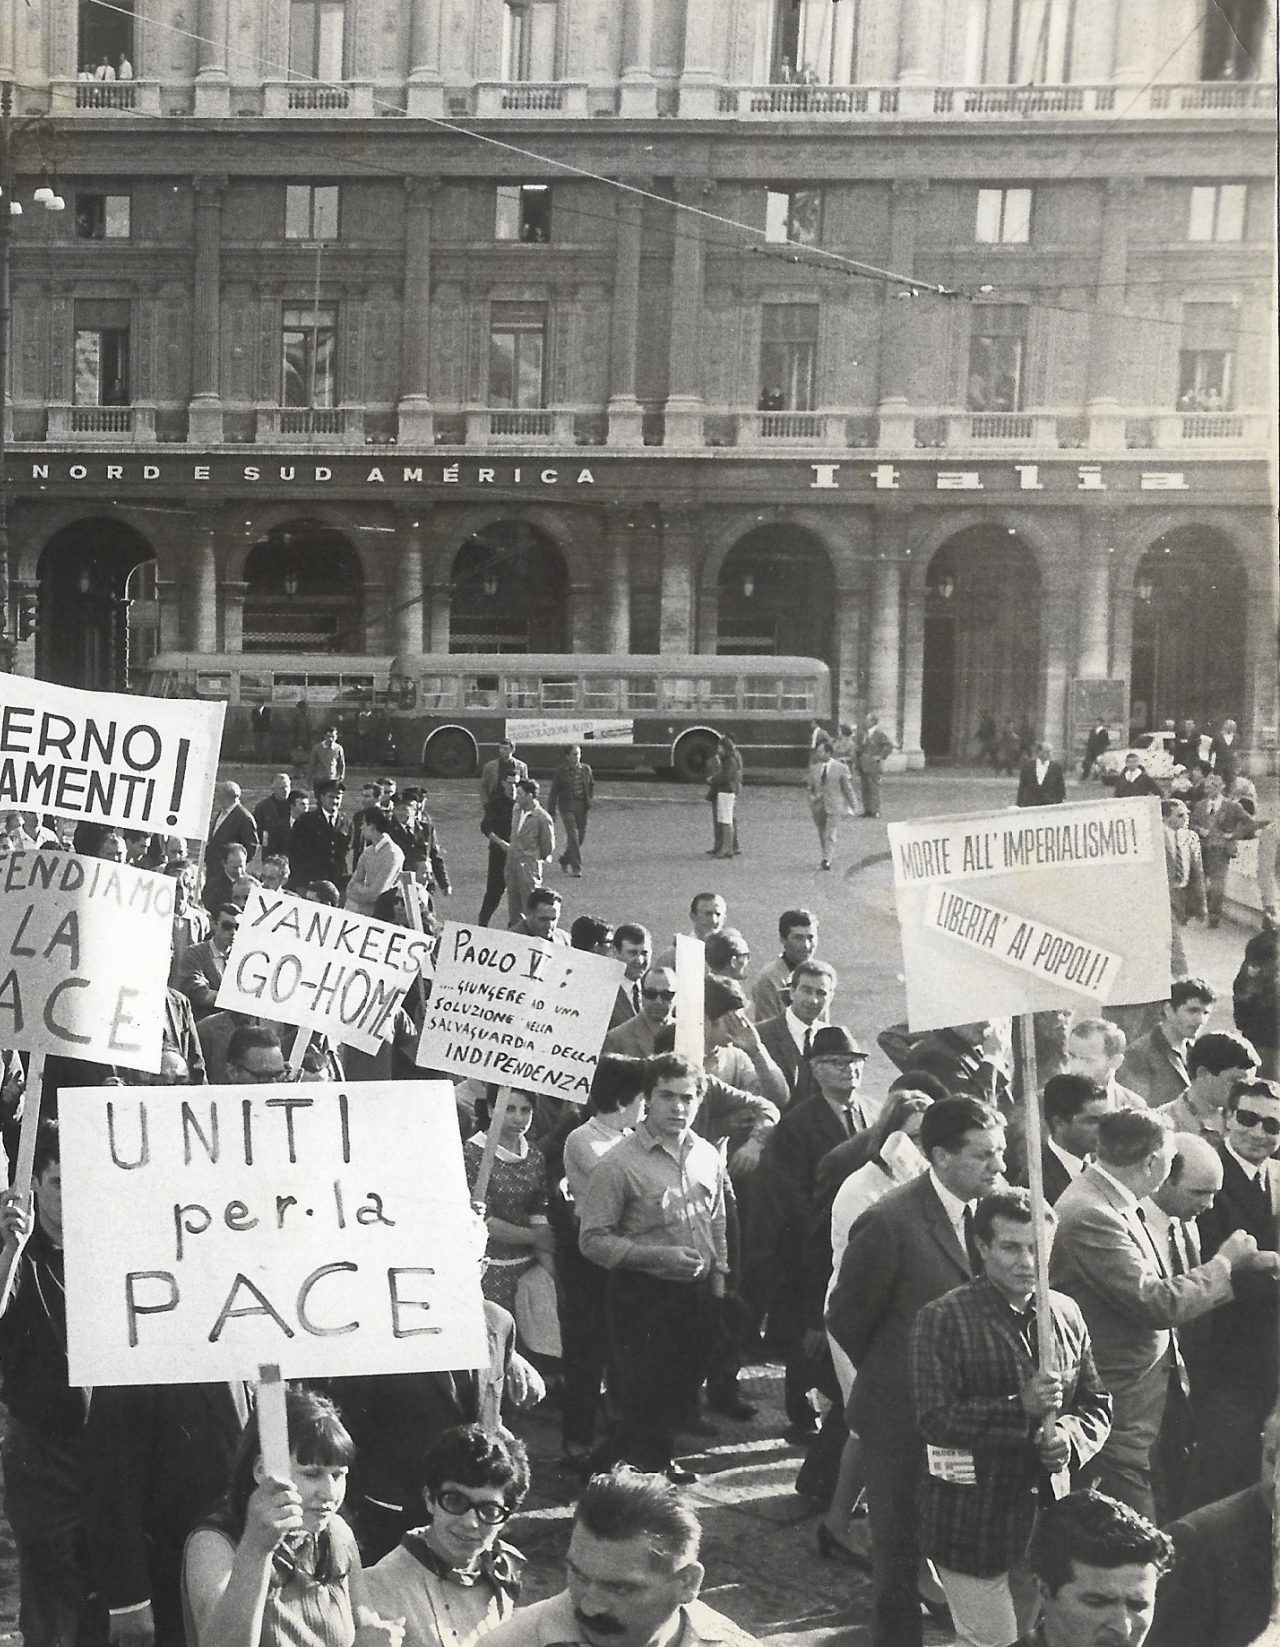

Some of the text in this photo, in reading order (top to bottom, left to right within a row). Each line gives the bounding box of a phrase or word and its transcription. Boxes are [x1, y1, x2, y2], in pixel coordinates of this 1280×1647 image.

[33, 462, 594, 484] NORD E SUD AMÉRICA
[811, 464, 1189, 489] Italia
[899, 837, 951, 881] MORTE
[10, 904, 80, 970] LA
[936, 891, 1109, 990] LIBERTA' AI POPOLI!
[434, 997, 514, 1024] SOLUZIONE
[428, 1017, 598, 1065] SALVAGUARDIA DELLA
[445, 1042, 590, 1094] INDIPENDENZA
[107, 1094, 350, 1170] UNITI
[125, 1261, 442, 1348] PACE
